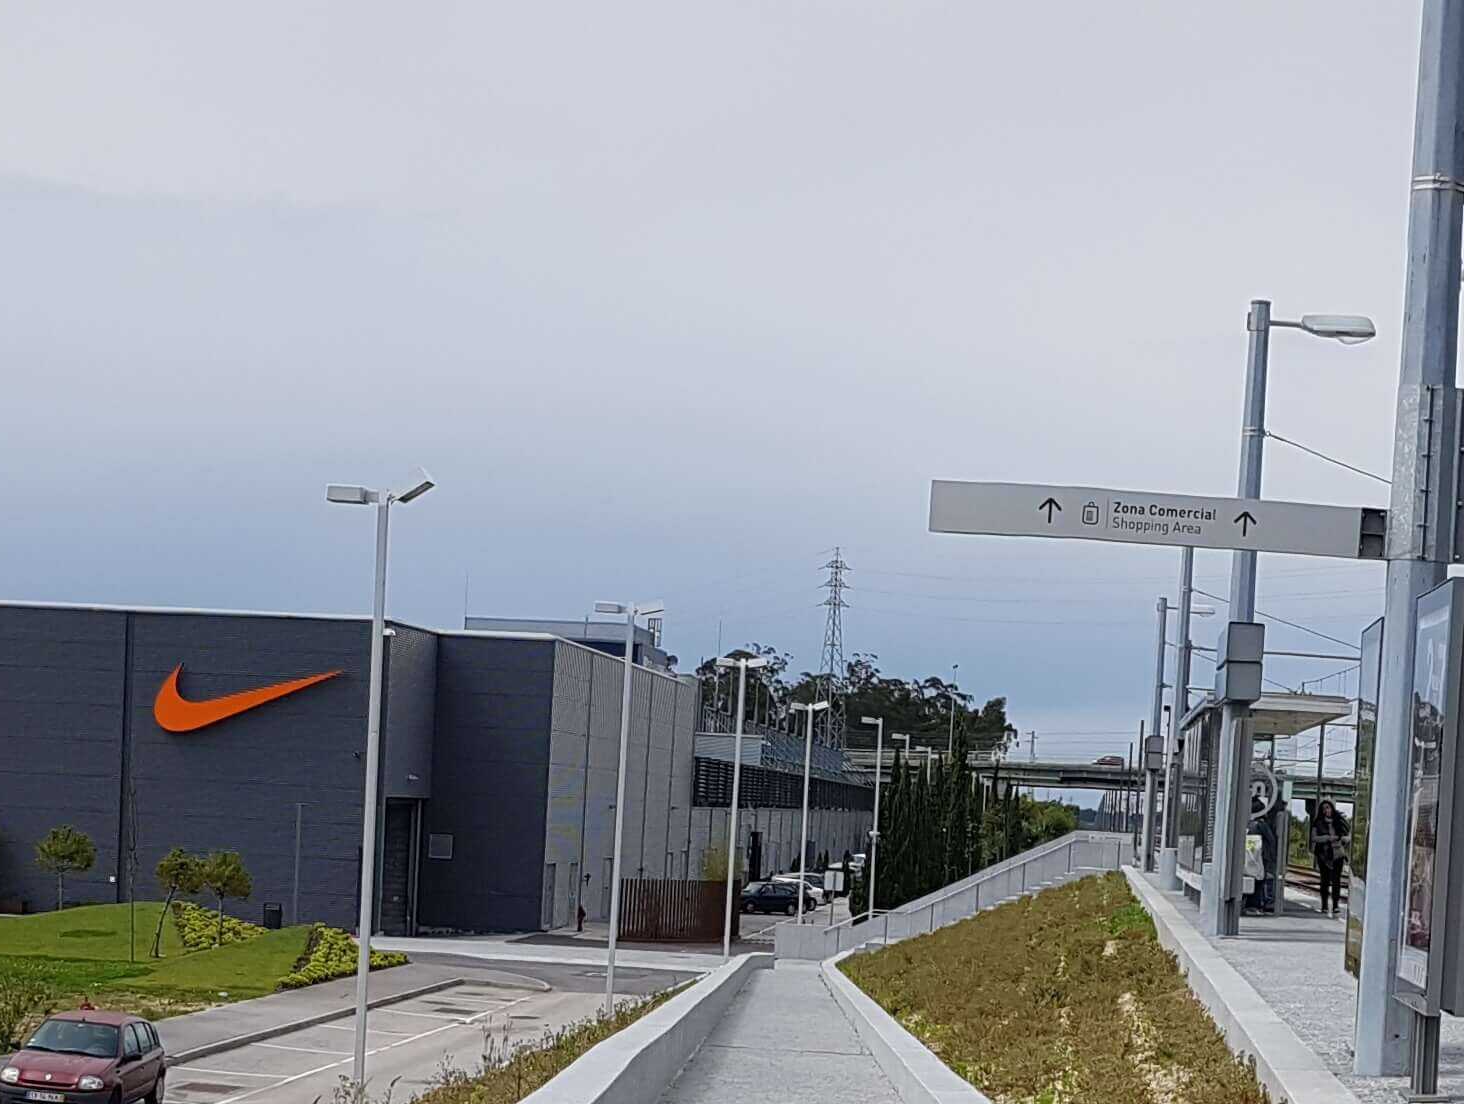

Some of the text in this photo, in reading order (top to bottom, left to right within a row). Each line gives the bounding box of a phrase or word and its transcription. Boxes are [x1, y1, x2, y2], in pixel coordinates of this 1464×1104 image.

[1113, 501, 1216, 520] Zona Comercial
[1112, 517, 1202, 535] Shopping Area
